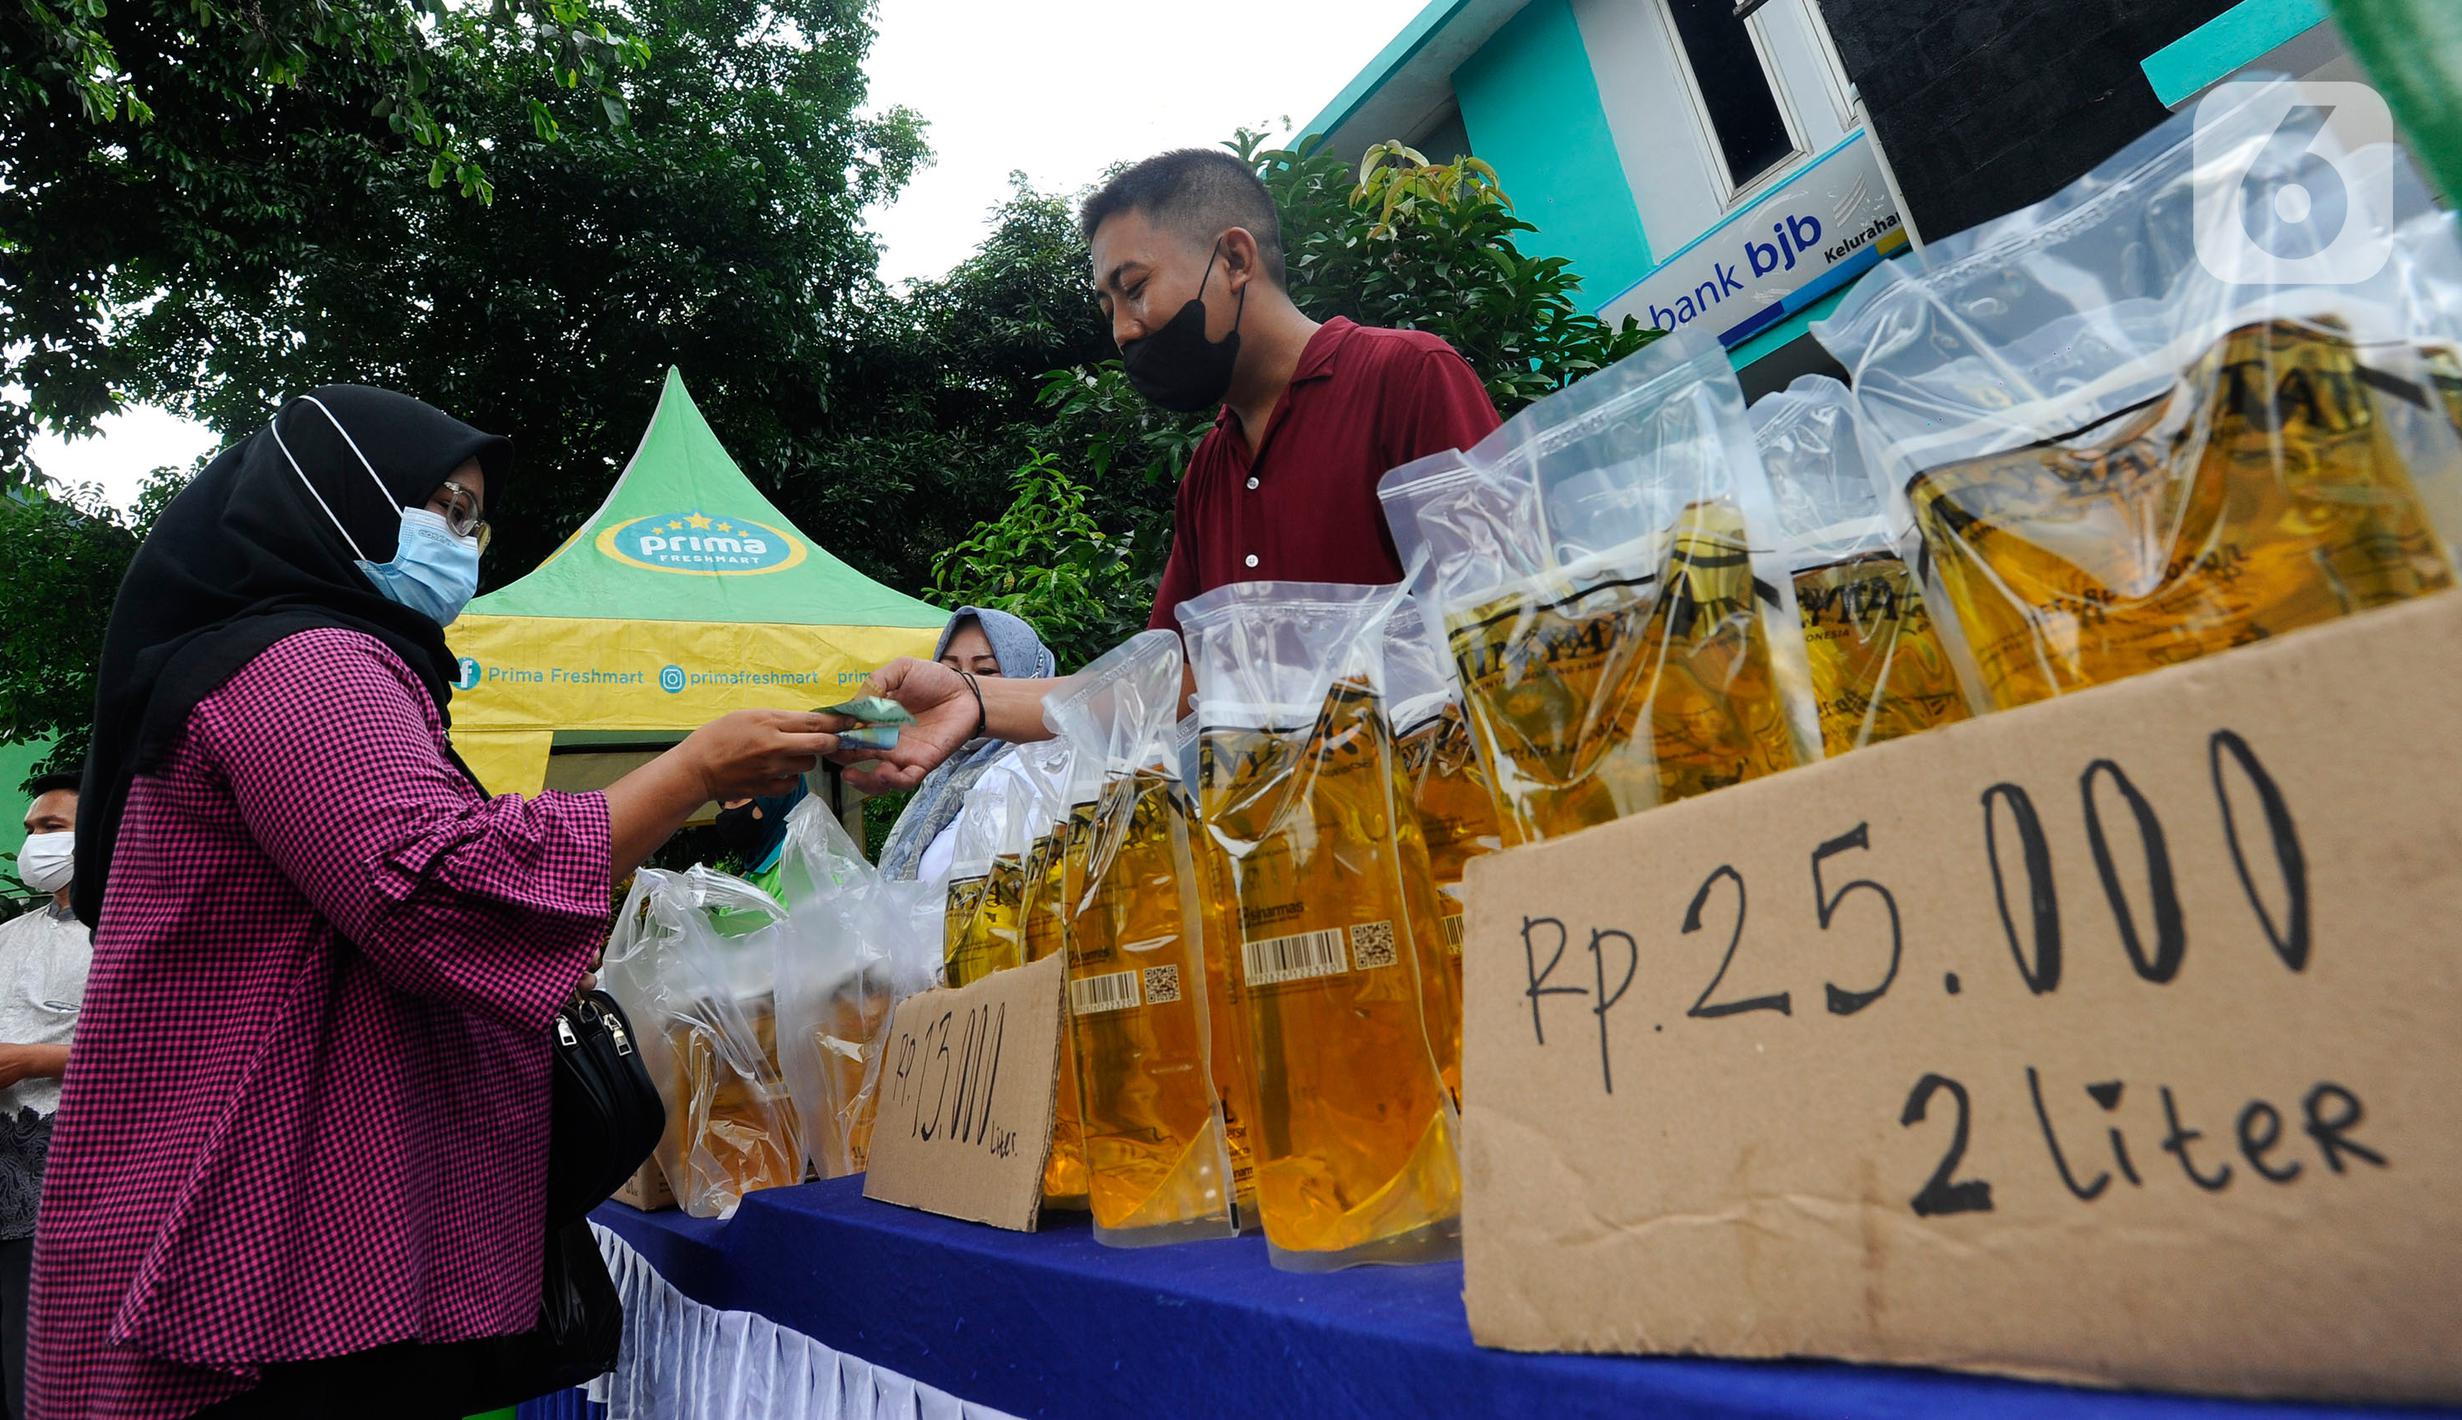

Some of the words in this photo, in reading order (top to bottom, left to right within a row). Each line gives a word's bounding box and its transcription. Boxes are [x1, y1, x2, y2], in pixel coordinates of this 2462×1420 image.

[1649, 262, 1745, 332] bank
[1744, 214, 1822, 279] bjb
[640, 536, 768, 556] prima
[660, 554, 760, 565] FRESHMART
[488, 667, 544, 683] Prima
[551, 668, 644, 684] Freshmart
[690, 671, 819, 685] primafreshmart
[1521, 916, 1663, 1094] Rp.
[1682, 729, 2310, 1018] 25.000
[1899, 1072, 1994, 1218] 2
